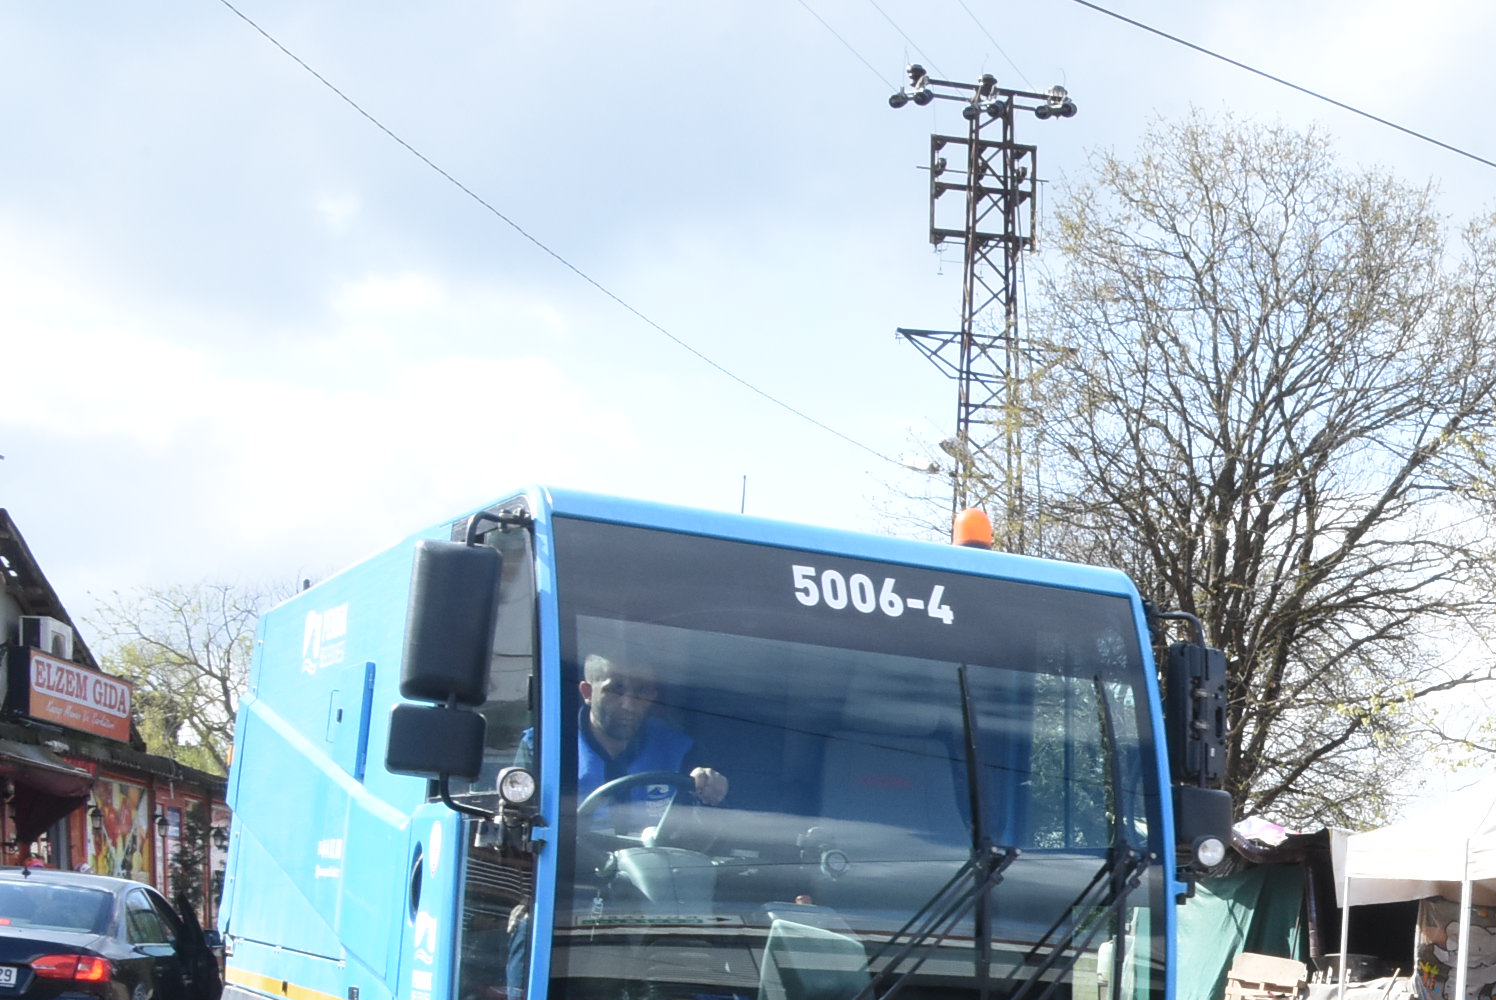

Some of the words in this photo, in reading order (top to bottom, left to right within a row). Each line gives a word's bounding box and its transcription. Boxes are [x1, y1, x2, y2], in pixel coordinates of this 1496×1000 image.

[792, 565, 954, 624] 5006-4
[35, 659, 88, 701] ELZEM
[93, 678, 127, 714] GIDA
